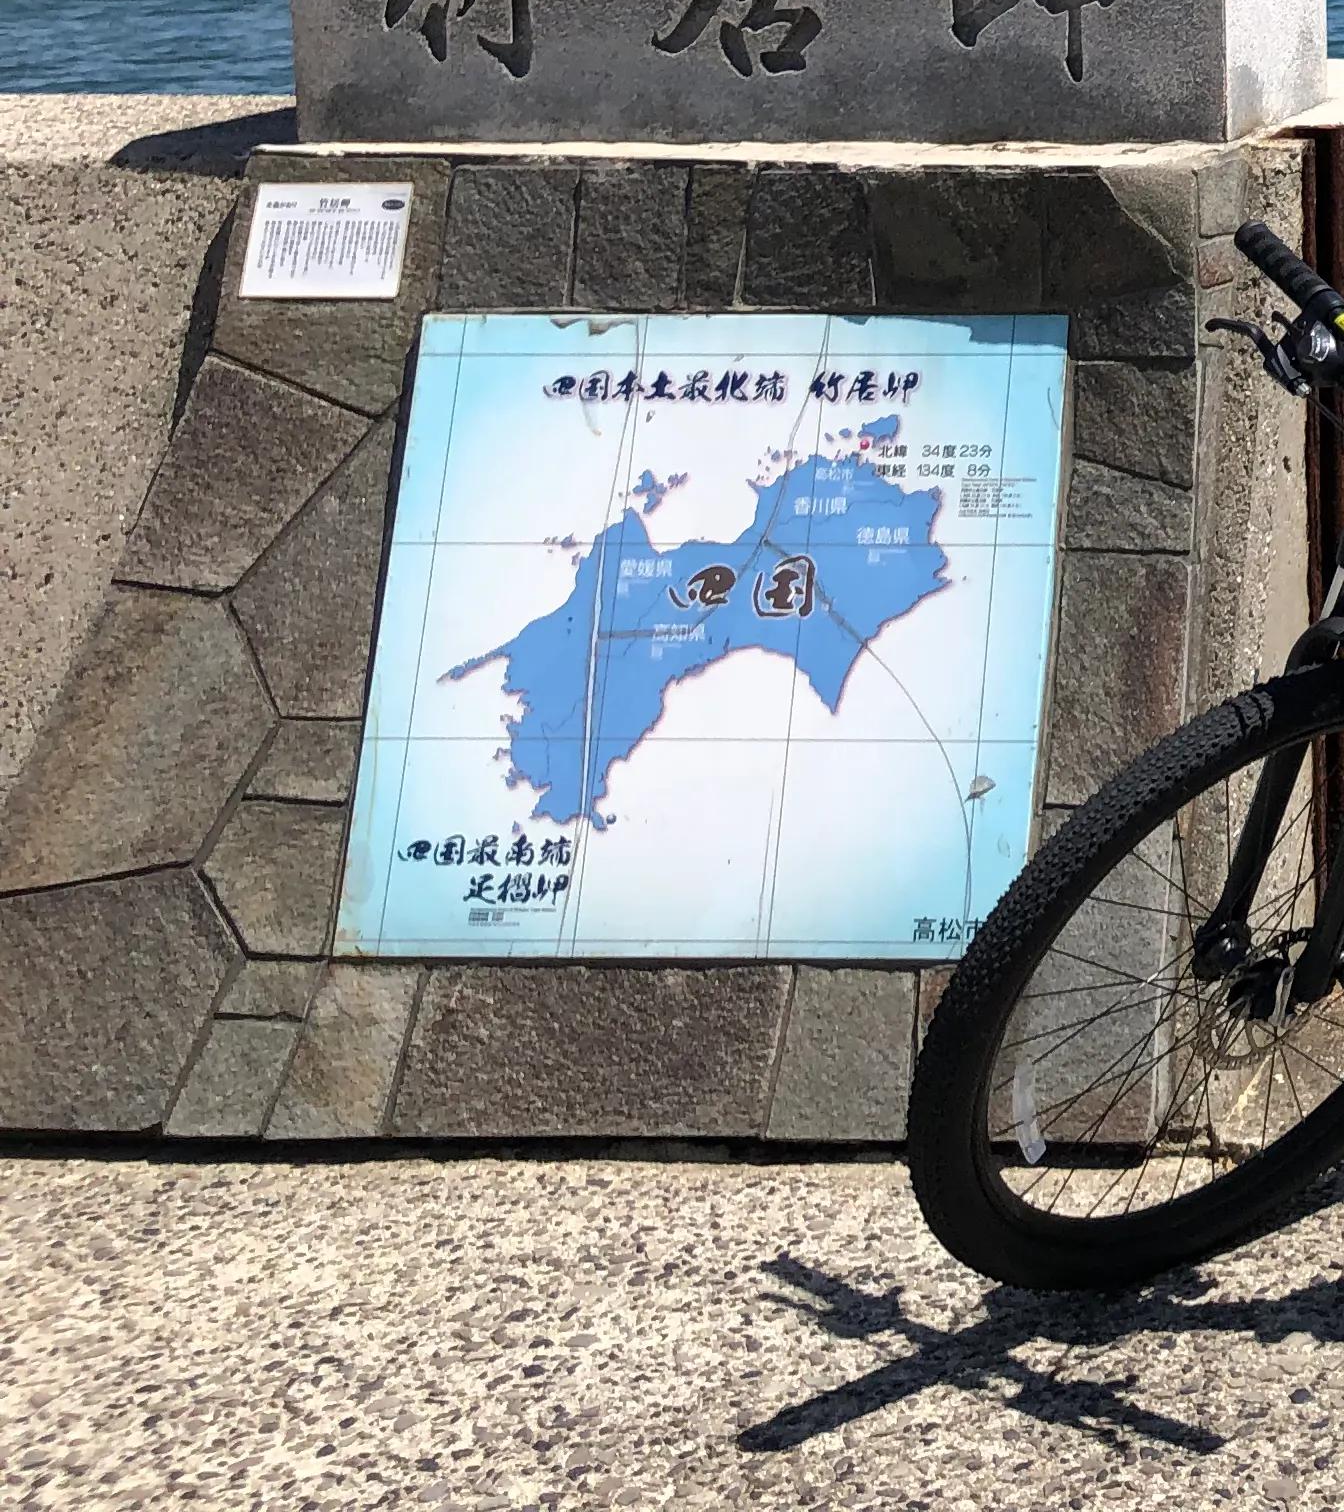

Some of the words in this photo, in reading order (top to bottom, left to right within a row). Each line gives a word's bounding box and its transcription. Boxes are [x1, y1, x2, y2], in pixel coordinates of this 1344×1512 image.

[542, 369, 787, 403] 四国本土最北端
[809, 369, 920, 404] 竹居岬
[878, 444, 909, 459] 北緯
[877, 463, 907, 478] 東経
[794, 496, 848, 516] 香川県
[856, 526, 910, 544] 徳島県
[668, 555, 816, 618] 四国
[397, 833, 572, 867] 四国最南端
[463, 871, 570, 906] 足摺岬
